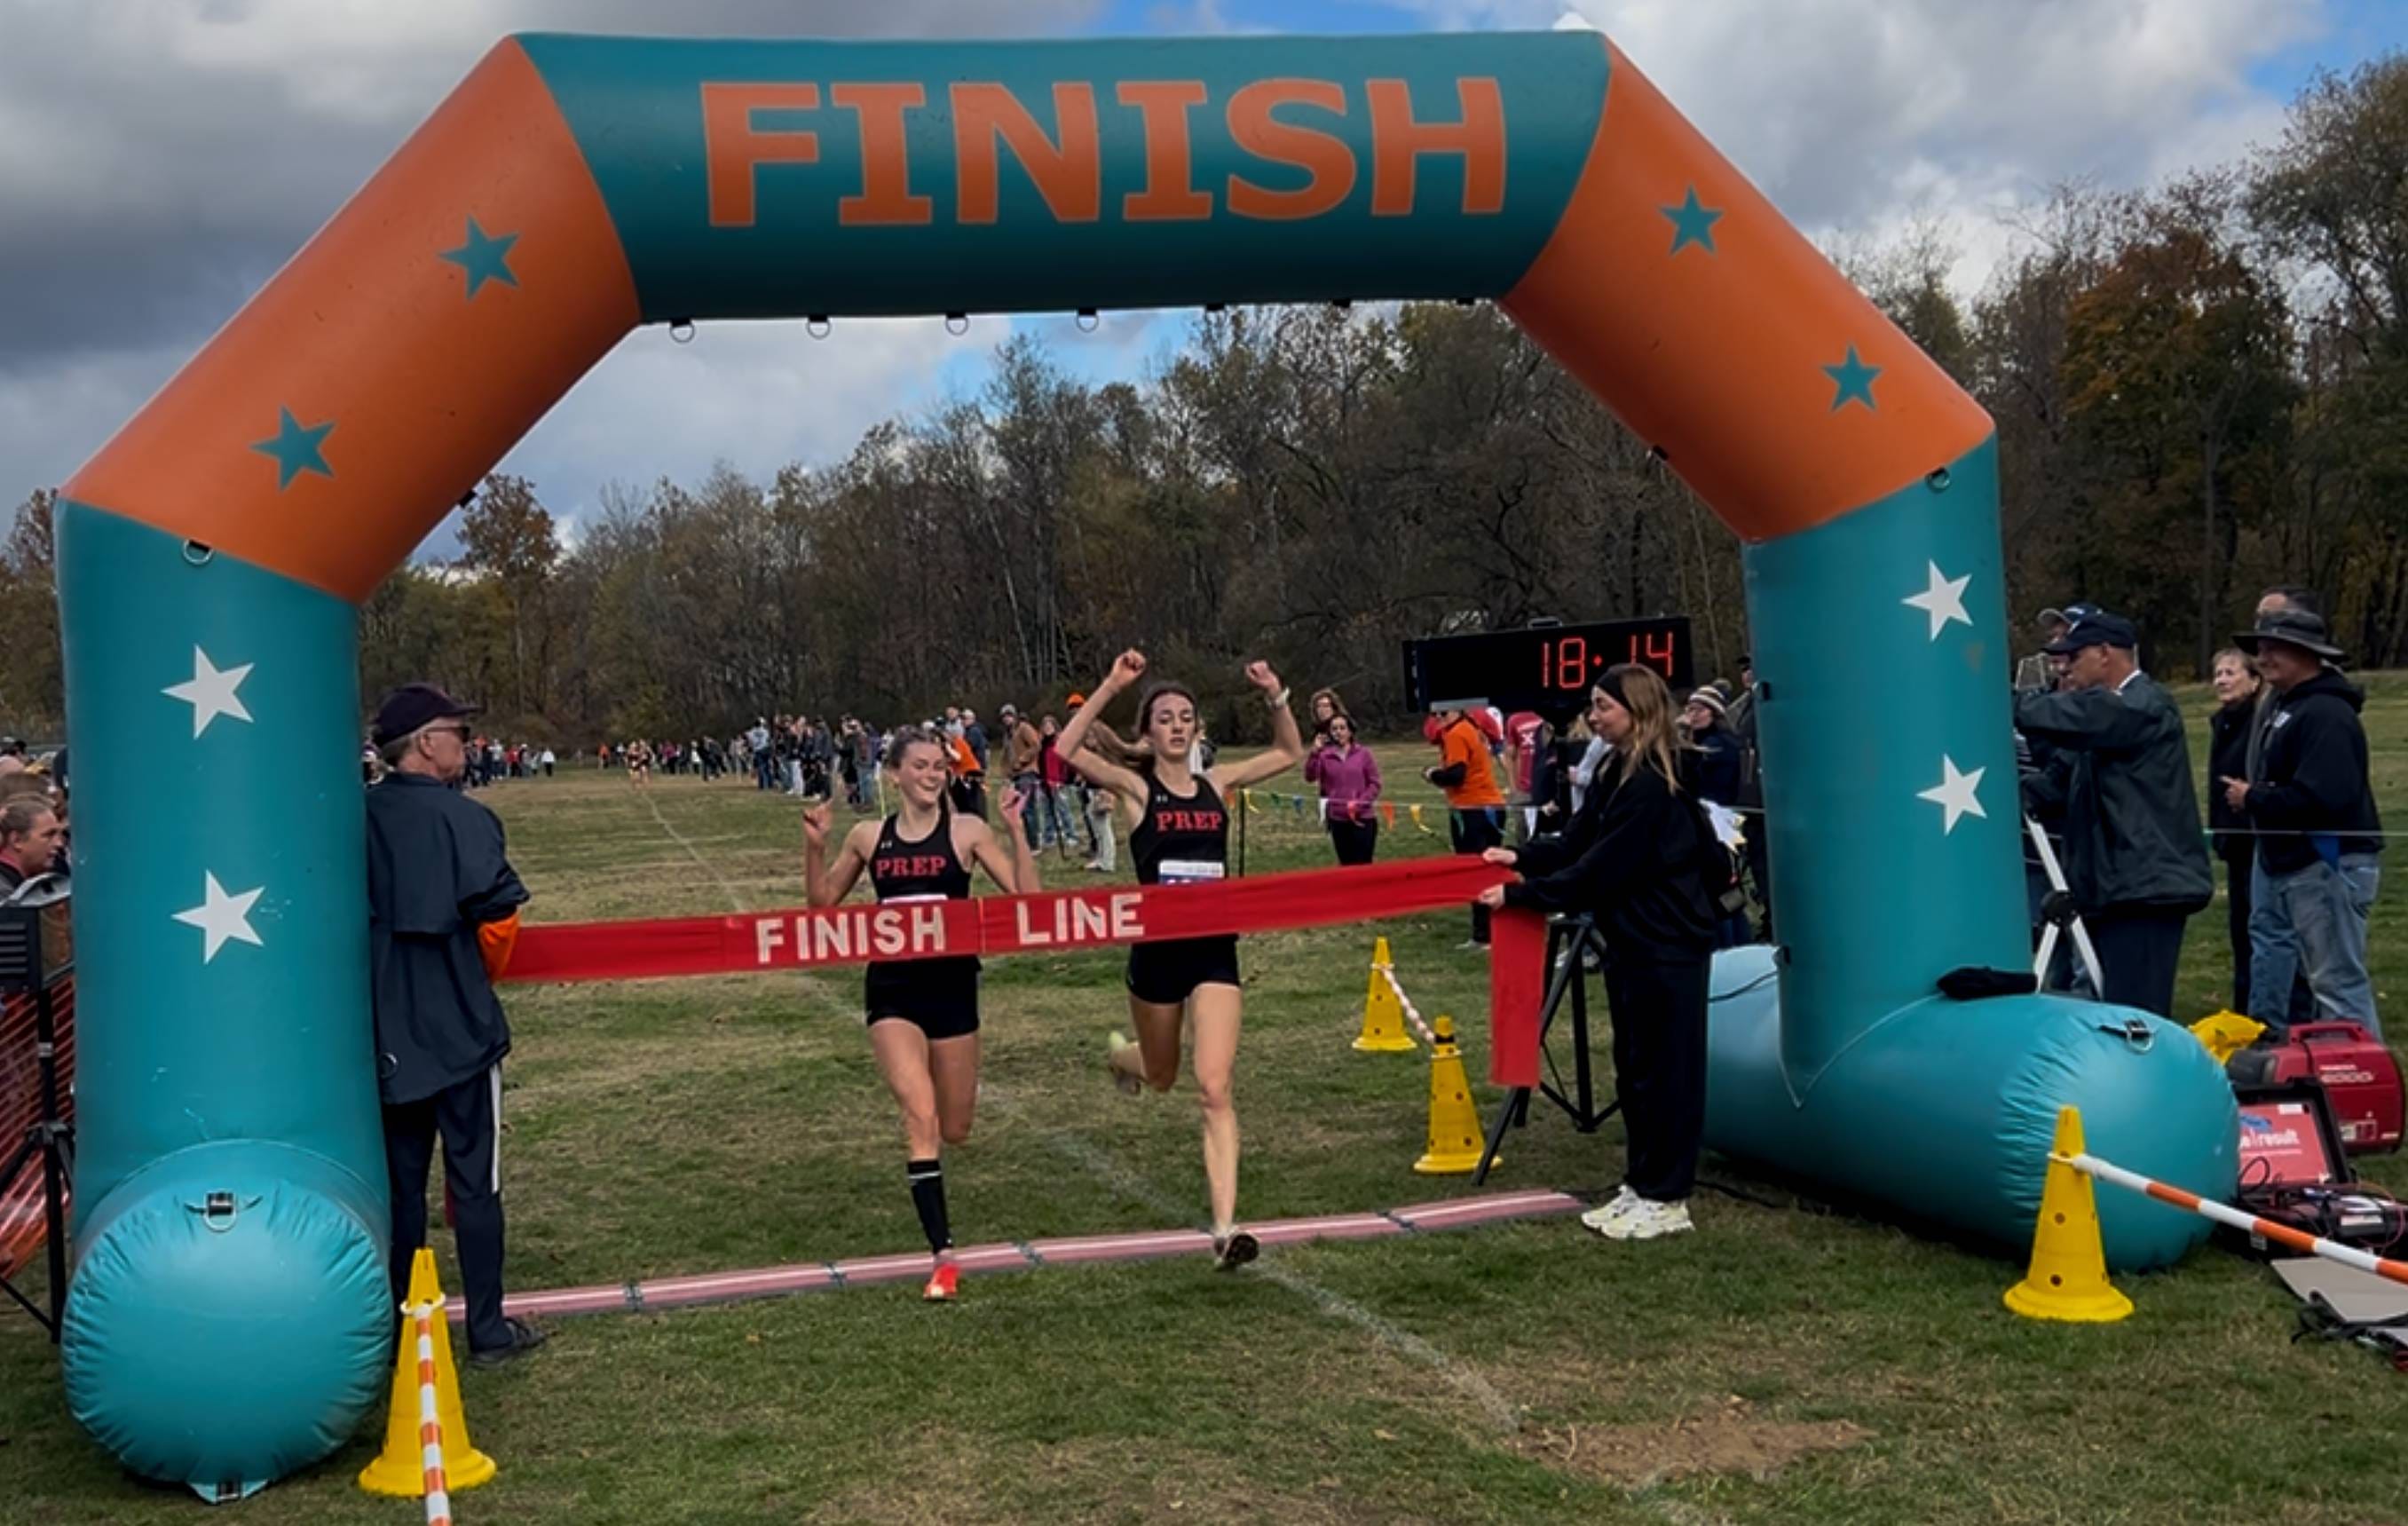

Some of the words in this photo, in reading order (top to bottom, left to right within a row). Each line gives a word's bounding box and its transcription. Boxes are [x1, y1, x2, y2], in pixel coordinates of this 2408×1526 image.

[700, 76, 1506, 227] FINISH
[1156, 810, 1222, 832] PREP
[875, 855, 947, 880] PREP
[755, 905, 946, 963] FINISH
[1015, 892, 1144, 945] LINE
